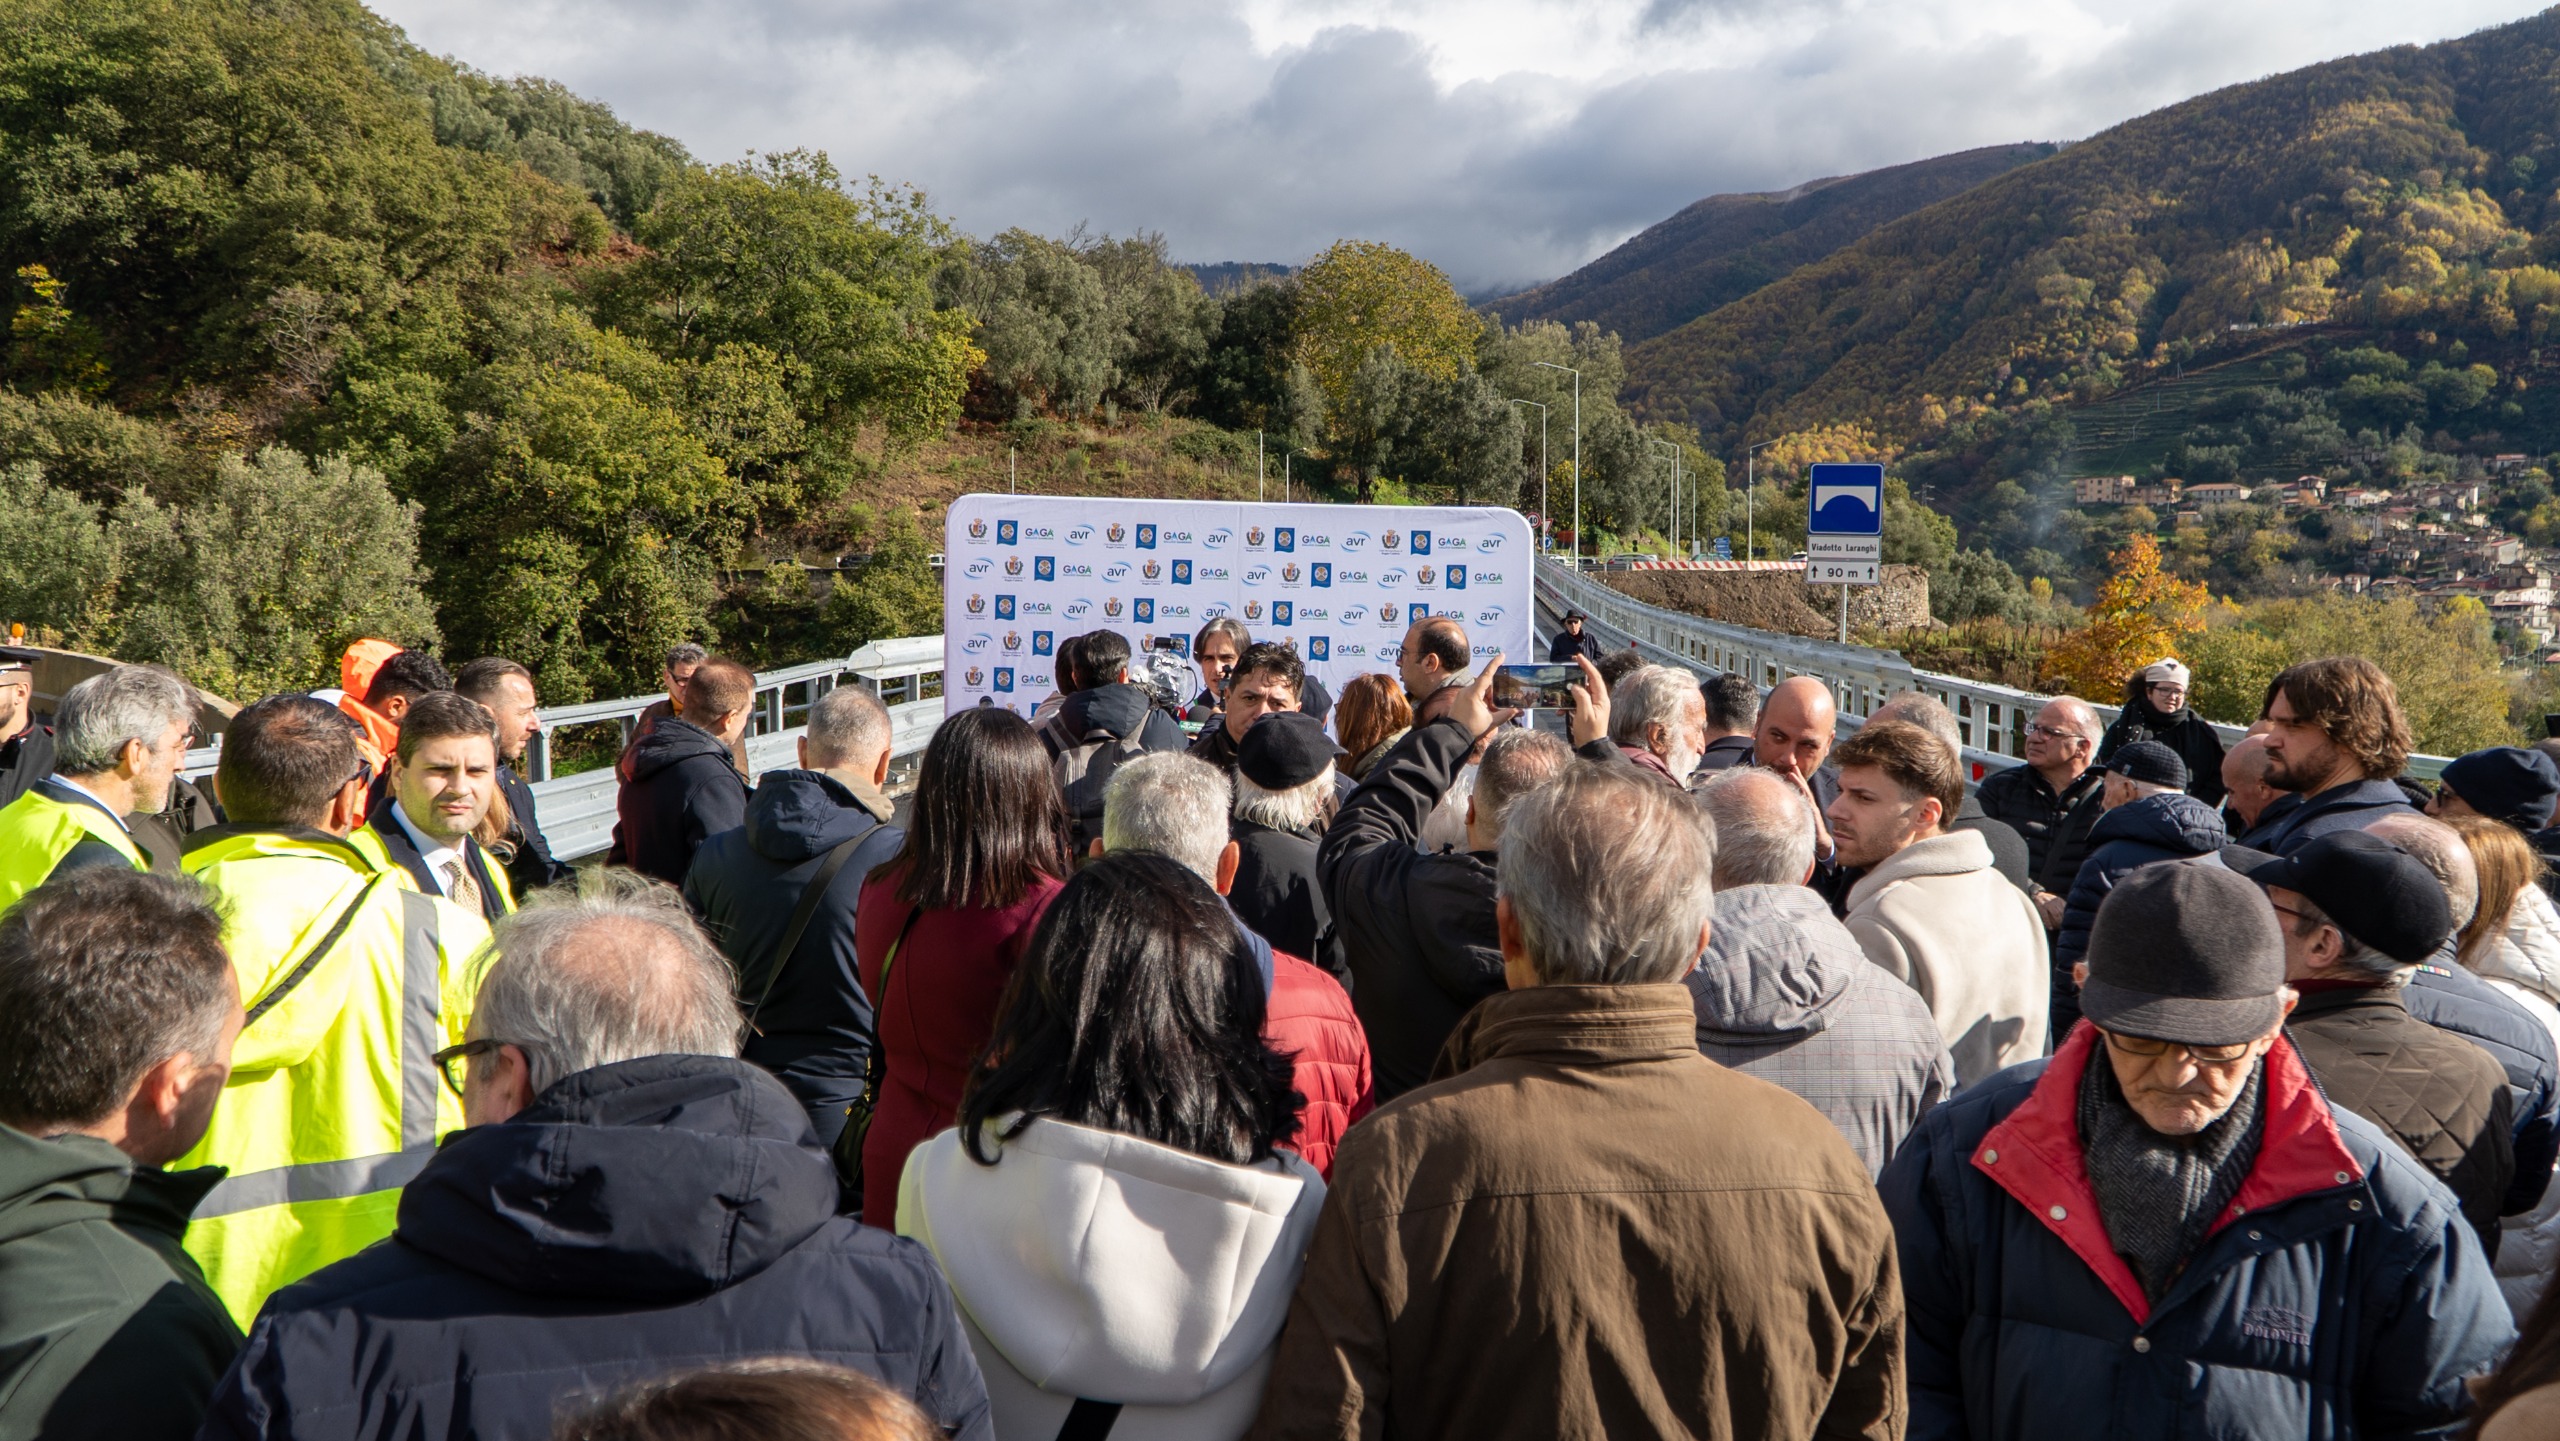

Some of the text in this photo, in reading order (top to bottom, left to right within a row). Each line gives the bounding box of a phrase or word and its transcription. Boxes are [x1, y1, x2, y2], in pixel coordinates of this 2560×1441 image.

[1025, 528, 1054, 537] GAGA
[1070, 530, 1090, 540] avr
[1164, 532, 1192, 541] GAGA
[1208, 534, 1228, 543] avr
[1302, 535, 1330, 544] GAGA
[1346, 537, 1366, 546] avr
[1438, 538, 1467, 546] GAGA
[1482, 539, 1502, 548] avr
[1811, 543, 1877, 554] Viadotto Laranghi
[969, 564, 989, 573] avr
[1063, 565, 1092, 574] GAGA
[1107, 568, 1127, 577] avr
[1200, 568, 1229, 577] GAGA
[1827, 568, 1858, 578] 90 m
[1247, 571, 1267, 580] avr
[1339, 571, 1368, 580] GAGA
[1382, 574, 1402, 583] avr
[1474, 573, 1503, 582] GAGA
[1023, 602, 1052, 612] GAGA
[1068, 605, 1088, 614] avr
[1161, 606, 1190, 615] GAGA
[1206, 608, 1226, 617] avr
[1300, 608, 1328, 618] GAGA
[1344, 611, 1364, 620] avr
[1437, 610, 1465, 619] GAGA
[1480, 612, 1500, 621] avr
[968, 639, 988, 648] avr
[1337, 645, 1366, 654] GAGA
[1472, 646, 1501, 655] GAGA
[1021, 675, 1050, 684] GAGA
